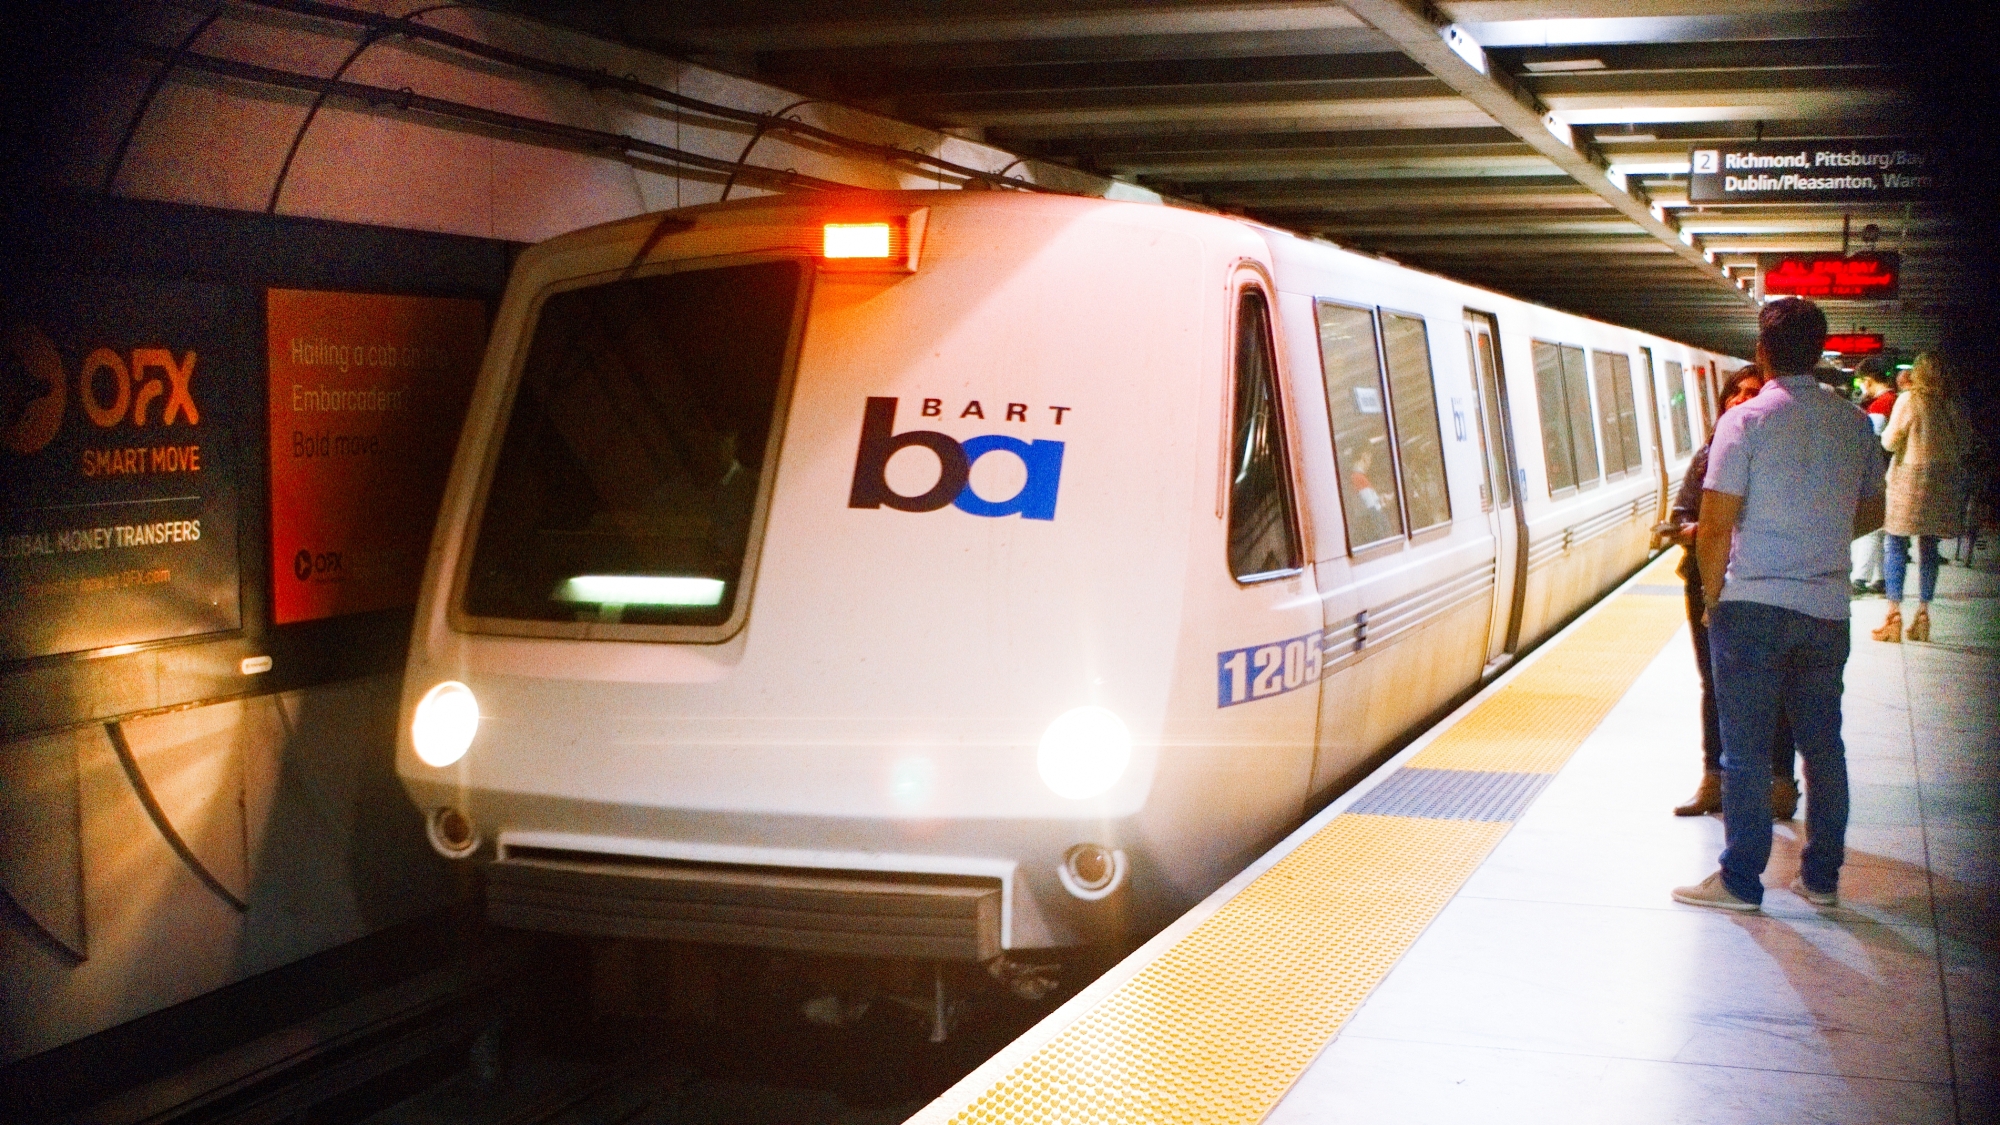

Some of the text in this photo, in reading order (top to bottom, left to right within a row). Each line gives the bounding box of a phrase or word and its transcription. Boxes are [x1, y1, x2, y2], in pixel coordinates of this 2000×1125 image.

[1700, 153, 1711, 169] 2
[1725, 152, 1810, 170] Richmond,
[1725, 173, 1878, 191] Dublin/Pleasanton,
[291, 337, 349, 372] Hailing
[353, 345, 364, 366] a
[369, 341, 397, 367] cab
[82, 347, 199, 427] OFX
[921, 397, 1071, 426] BART
[293, 429, 330, 458] Bold
[83, 445, 200, 476] SMART MOVE
[57, 527, 113, 553] MONEY
[115, 519, 200, 548] TRANSFERS
[313, 552, 343, 573] OFX
[1223, 633, 1323, 702] 1205
